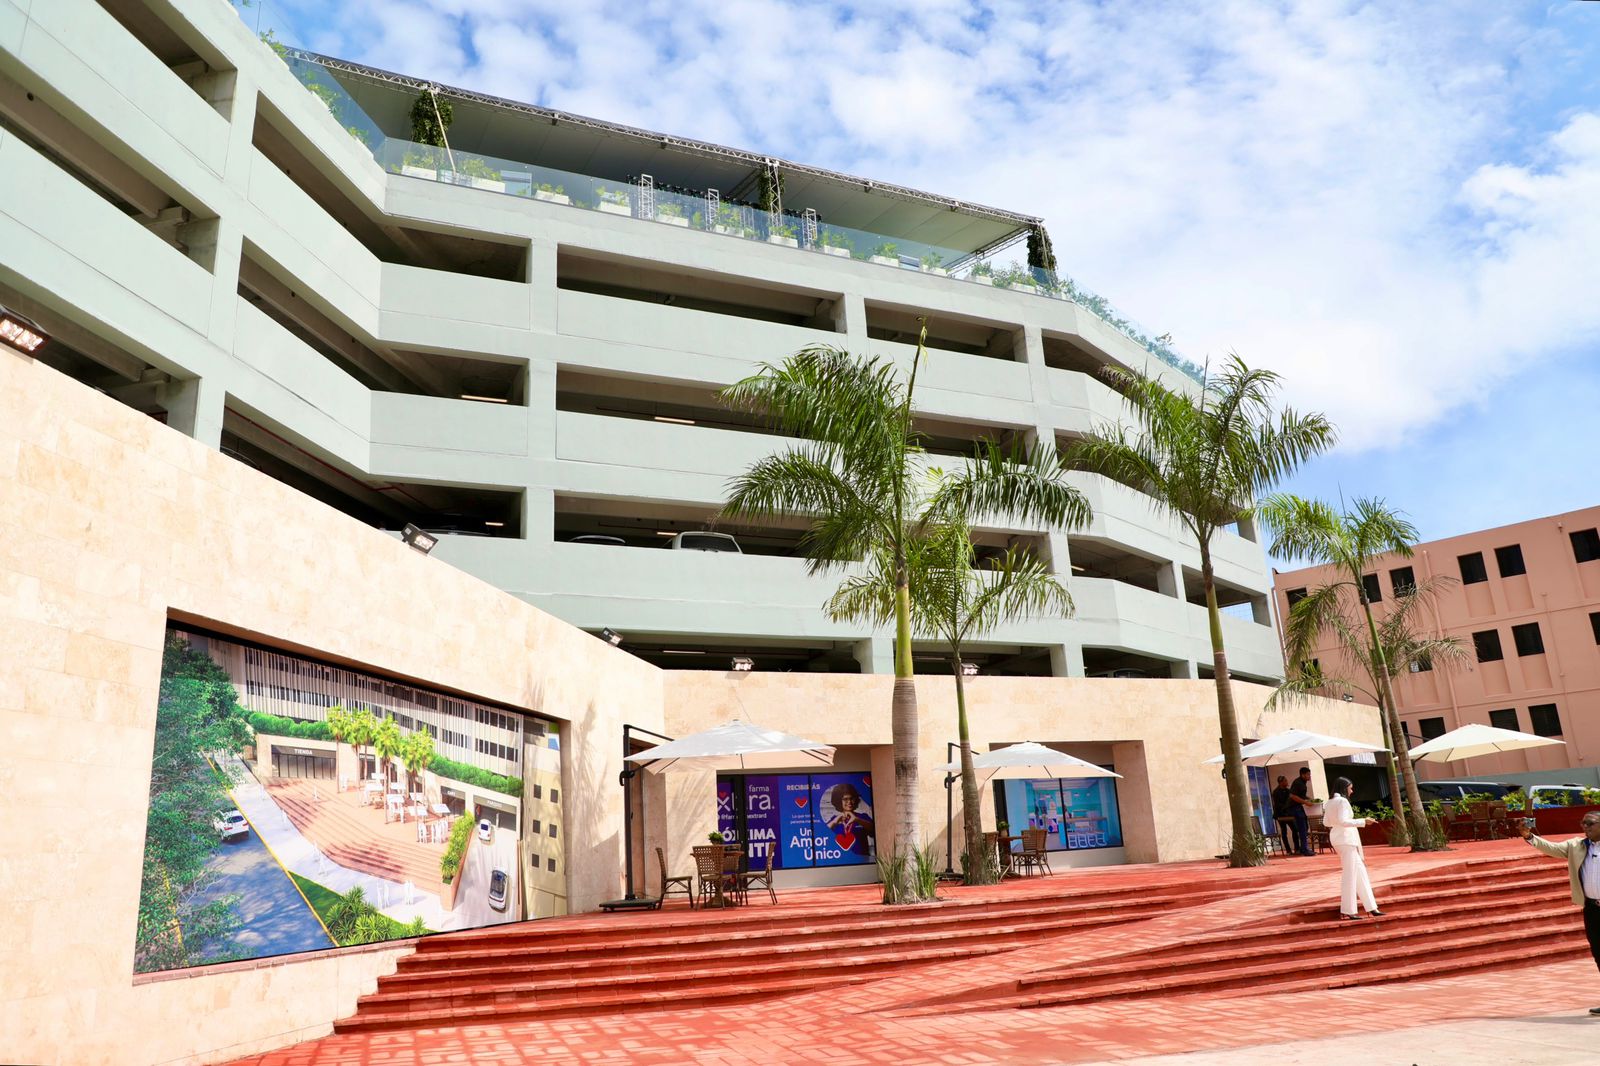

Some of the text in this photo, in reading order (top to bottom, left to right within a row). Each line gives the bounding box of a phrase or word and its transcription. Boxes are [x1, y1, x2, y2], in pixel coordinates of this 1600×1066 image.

[748, 784, 770, 792] farma
[799, 827, 812, 837] Un
[790, 835, 829, 848] Amor
[804, 846, 841, 860] Único
